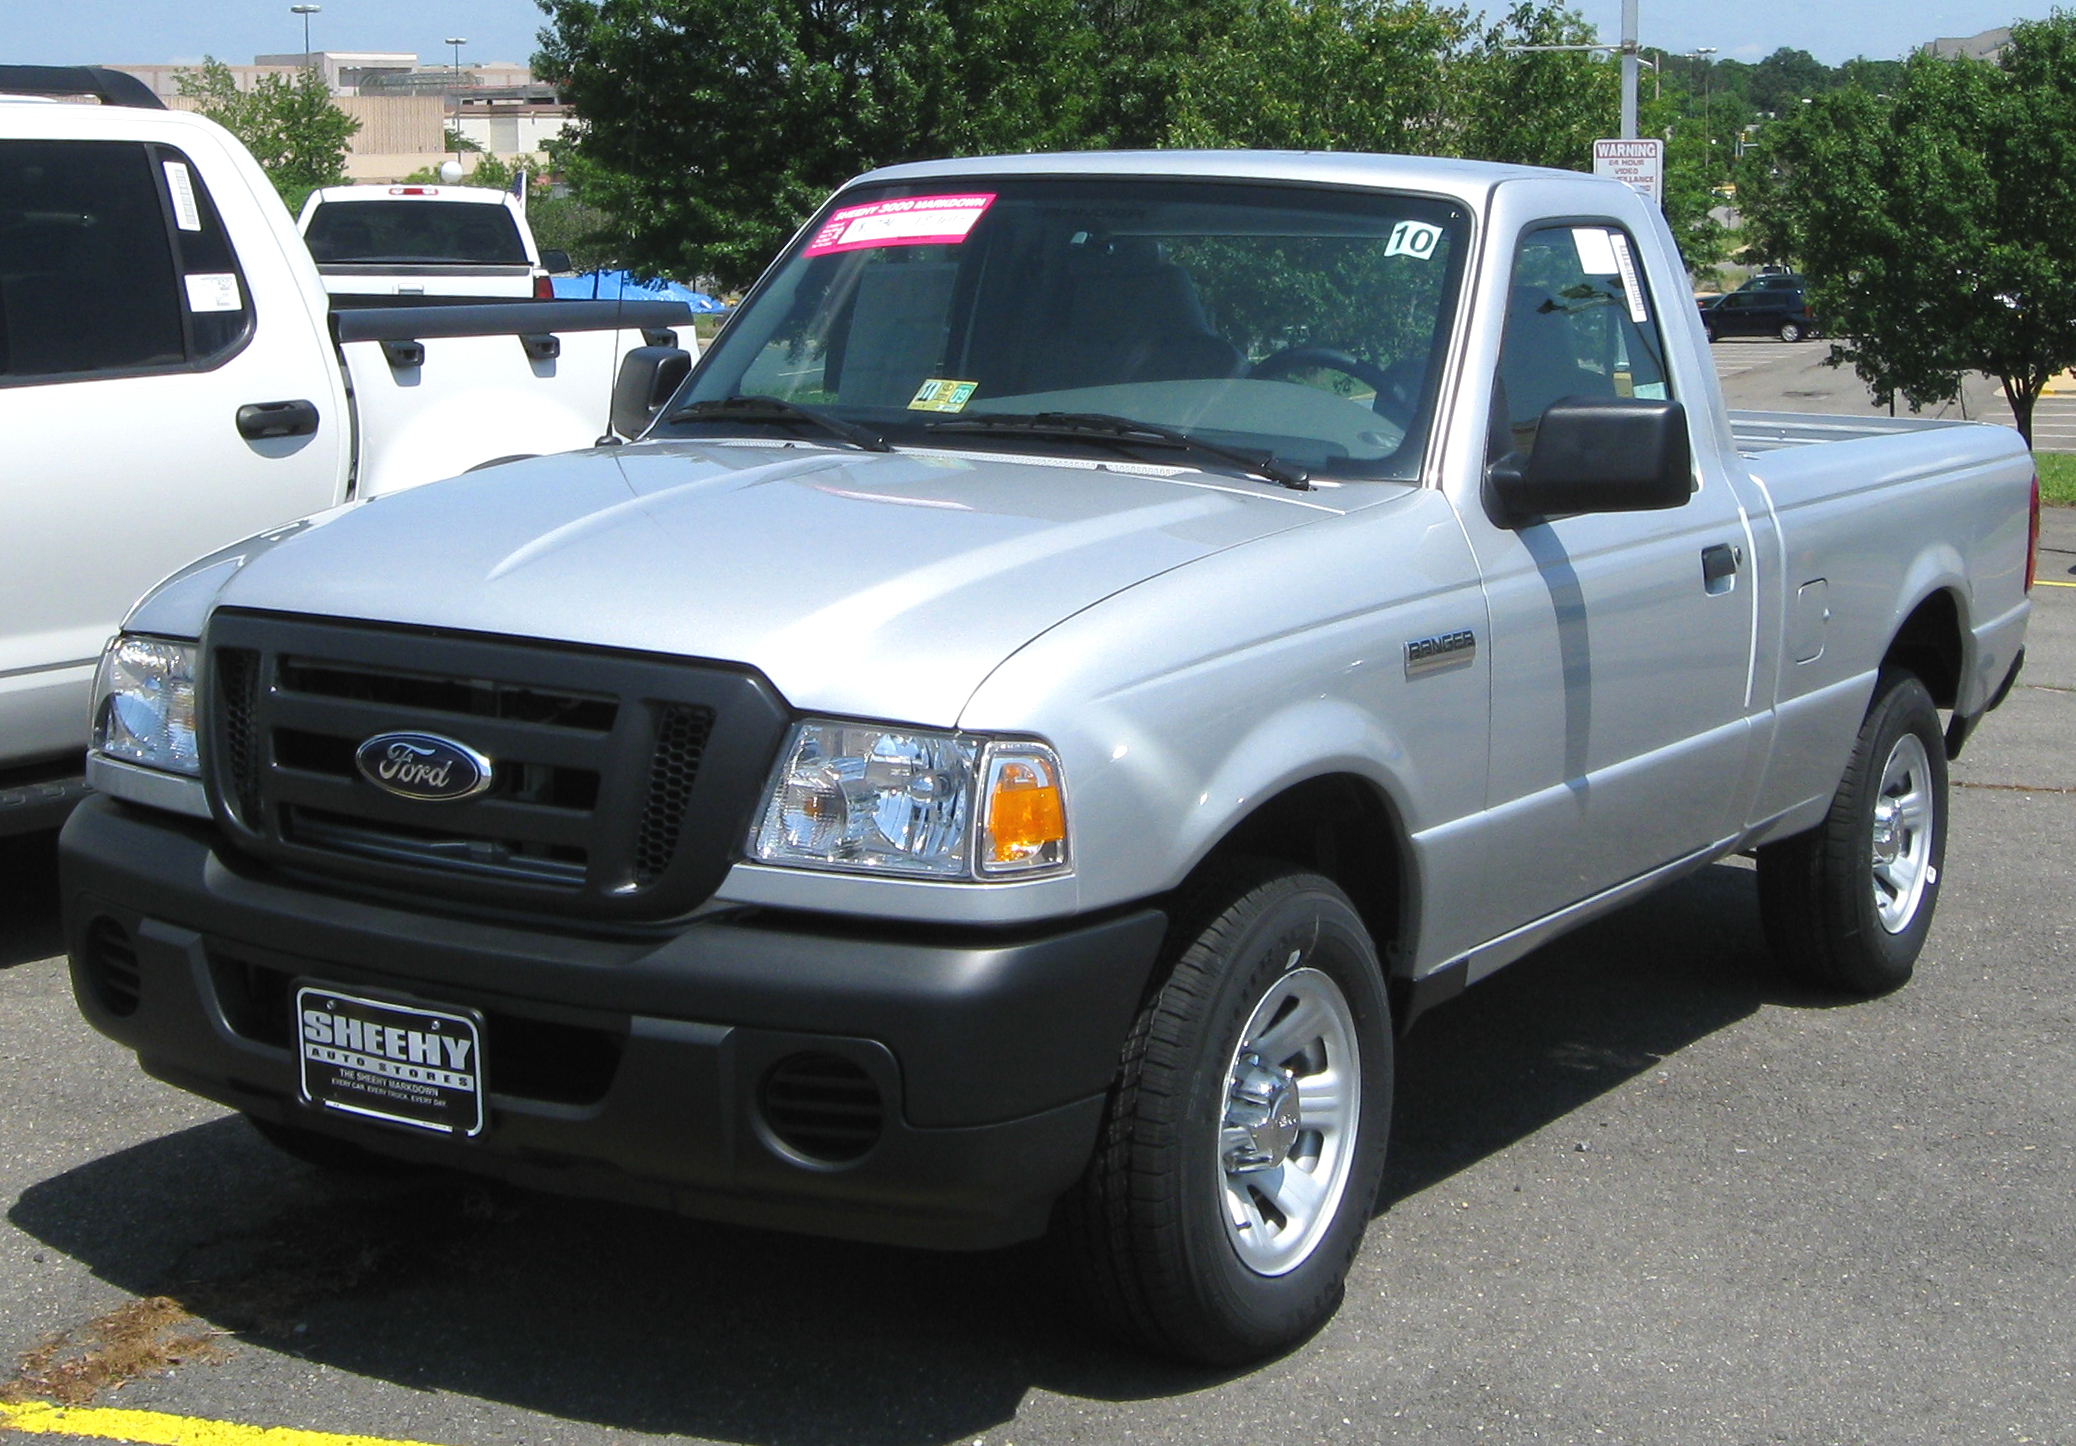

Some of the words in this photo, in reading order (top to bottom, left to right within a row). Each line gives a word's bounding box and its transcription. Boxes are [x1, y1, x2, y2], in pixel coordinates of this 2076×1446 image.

[1597, 143, 1656, 157] WARNING
[1615, 167, 1639, 175] VIDEO
[834, 205, 880, 221] SHEEHY
[878, 200, 916, 213] 3000
[912, 197, 987, 210] MARKDOWN
[1394, 225, 1434, 253] 10
[948, 388, 970, 404] 09
[1408, 629, 1476, 662] RANGER
[379, 742, 453, 788] Ford
[303, 1009, 472, 1071] SHEEHY
[311, 1047, 366, 1067] AUTO
[378, 1062, 468, 1087] STORES
[339, 1067, 355, 1080] THE
[356, 1071, 387, 1087] SHEEHY
[388, 1079, 439, 1097] MARKDOWN
